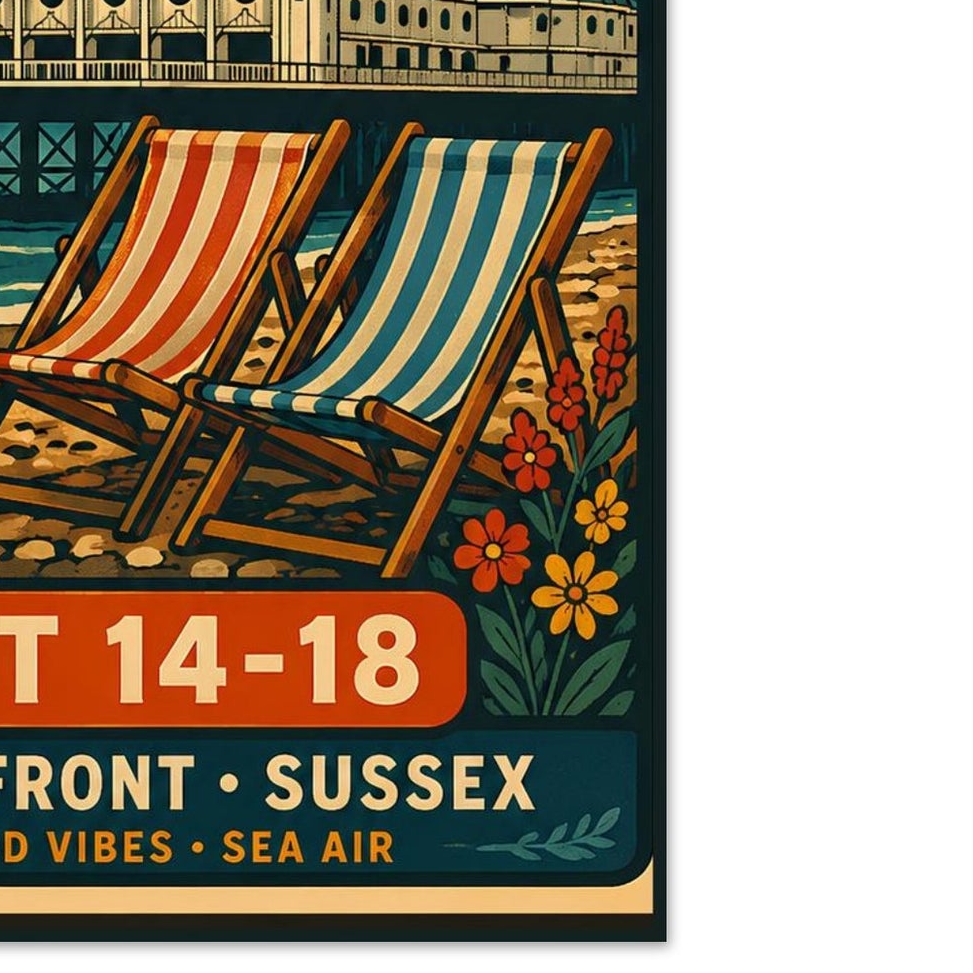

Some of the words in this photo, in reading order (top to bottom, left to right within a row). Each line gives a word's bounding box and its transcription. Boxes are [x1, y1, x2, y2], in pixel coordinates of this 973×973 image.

[107, 615, 421, 704] 14-18
[266, 755, 533, 810] SUSSEX
[48, 831, 172, 862] VIBES
[222, 831, 303, 862] SEA
[322, 831, 393, 862] AIR
